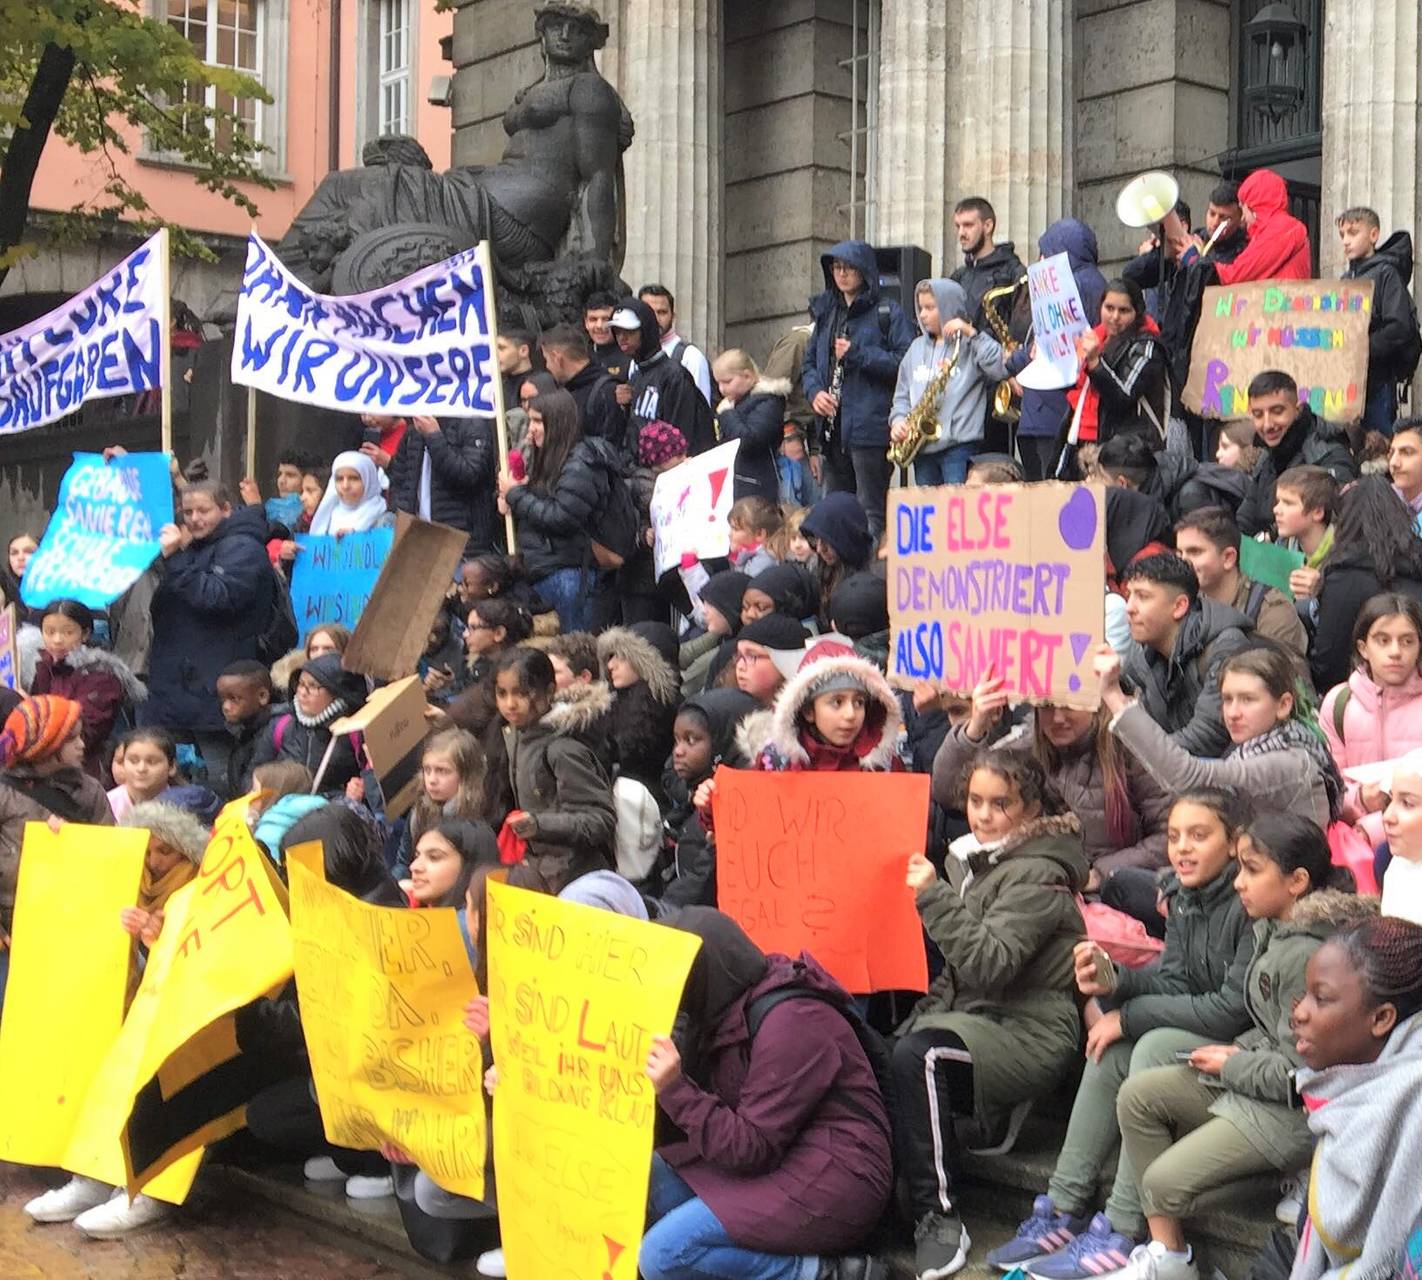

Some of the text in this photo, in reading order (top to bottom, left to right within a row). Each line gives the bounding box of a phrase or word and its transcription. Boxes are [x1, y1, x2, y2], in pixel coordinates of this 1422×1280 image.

[241, 313, 494, 411] WIR UNSERE
[896, 490, 1014, 556] DIE ELSE
[896, 560, 1072, 616] DEMONSTRIERT
[896, 620, 944, 680] ALSO
[777, 796, 846, 844] WIR
[577, 999, 649, 1067] LAUT
